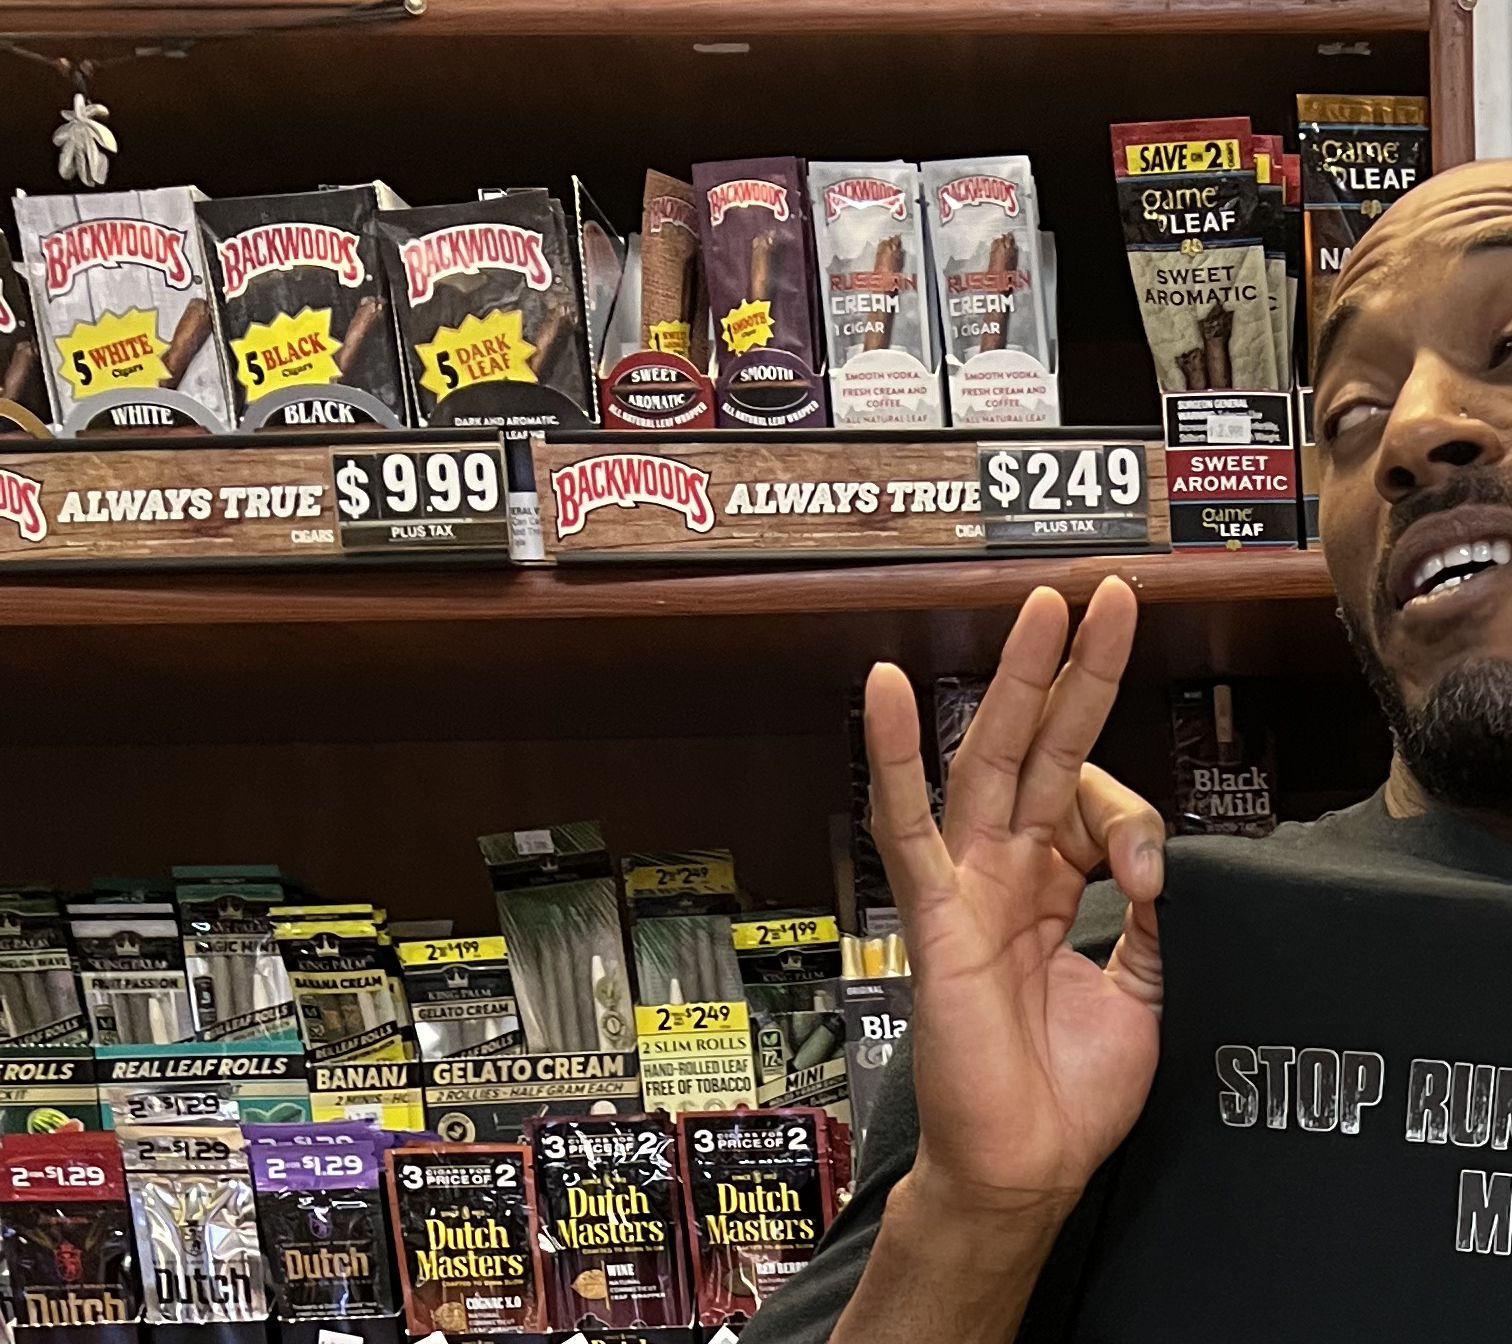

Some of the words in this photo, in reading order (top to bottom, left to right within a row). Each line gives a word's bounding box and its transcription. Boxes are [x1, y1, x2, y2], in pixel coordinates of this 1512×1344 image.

[1138, 144, 1188, 173] SAVE
[1141, 185, 1219, 219] game
[1169, 209, 1236, 234] LEAF
[39, 218, 194, 297] BACKWOODS
[400, 223, 553, 306] BACKWOODS
[1156, 266, 1234, 285] SWEET
[1144, 283, 1258, 305] AROMATIC
[73, 352, 92, 386] 5
[89, 333, 154, 371] WHITE
[246, 351, 265, 386] 5
[261, 335, 328, 371] BLACK
[438, 352, 459, 388] 5
[457, 332, 512, 365] DARK
[469, 353, 512, 381] LEAF
[631, 366, 678, 384] SWEET
[626, 392, 686, 408] AROMATIC
[110, 404, 174, 427] WHITE
[1190, 456, 1269, 473] SWEET
[551, 452, 712, 539] BACKWOODS
[1172, 472, 1289, 491] AROMATIC
[57, 486, 213, 525] ALWAYS
[220, 484, 323, 520] TRUE
[725, 481, 876, 517] ALWAYS
[885, 481, 981, 515] TRUE
[391, 524, 424, 539] PLUS
[427, 523, 454, 539] TAX
[1034, 520, 1066, 534] PLUS
[1069, 519, 1095, 534] TAX
[655, 1039, 693, 1053] SLIM
[696, 1036, 747, 1051] ROLLS
[112, 1061, 163, 1079] REAL
[166, 1059, 217, 1077] LEAF
[219, 1057, 288, 1076] ROLLS
[440, 1059, 534, 1084] GELATO
[537, 1055, 624, 1079] CREAM
[785, 1066, 825, 1091] MINI
[645, 1080, 674, 1095] FREE
[678, 1080, 693, 1094] OF
[695, 1077, 752, 1093] TOBACCO
[1215, 1045, 1384, 1135] STOP
[717, 1182, 801, 1214] Dutch
[425, 1218, 510, 1250] Dutch
[706, 1215, 815, 1245] Masters
[416, 1251, 525, 1281] Masters
